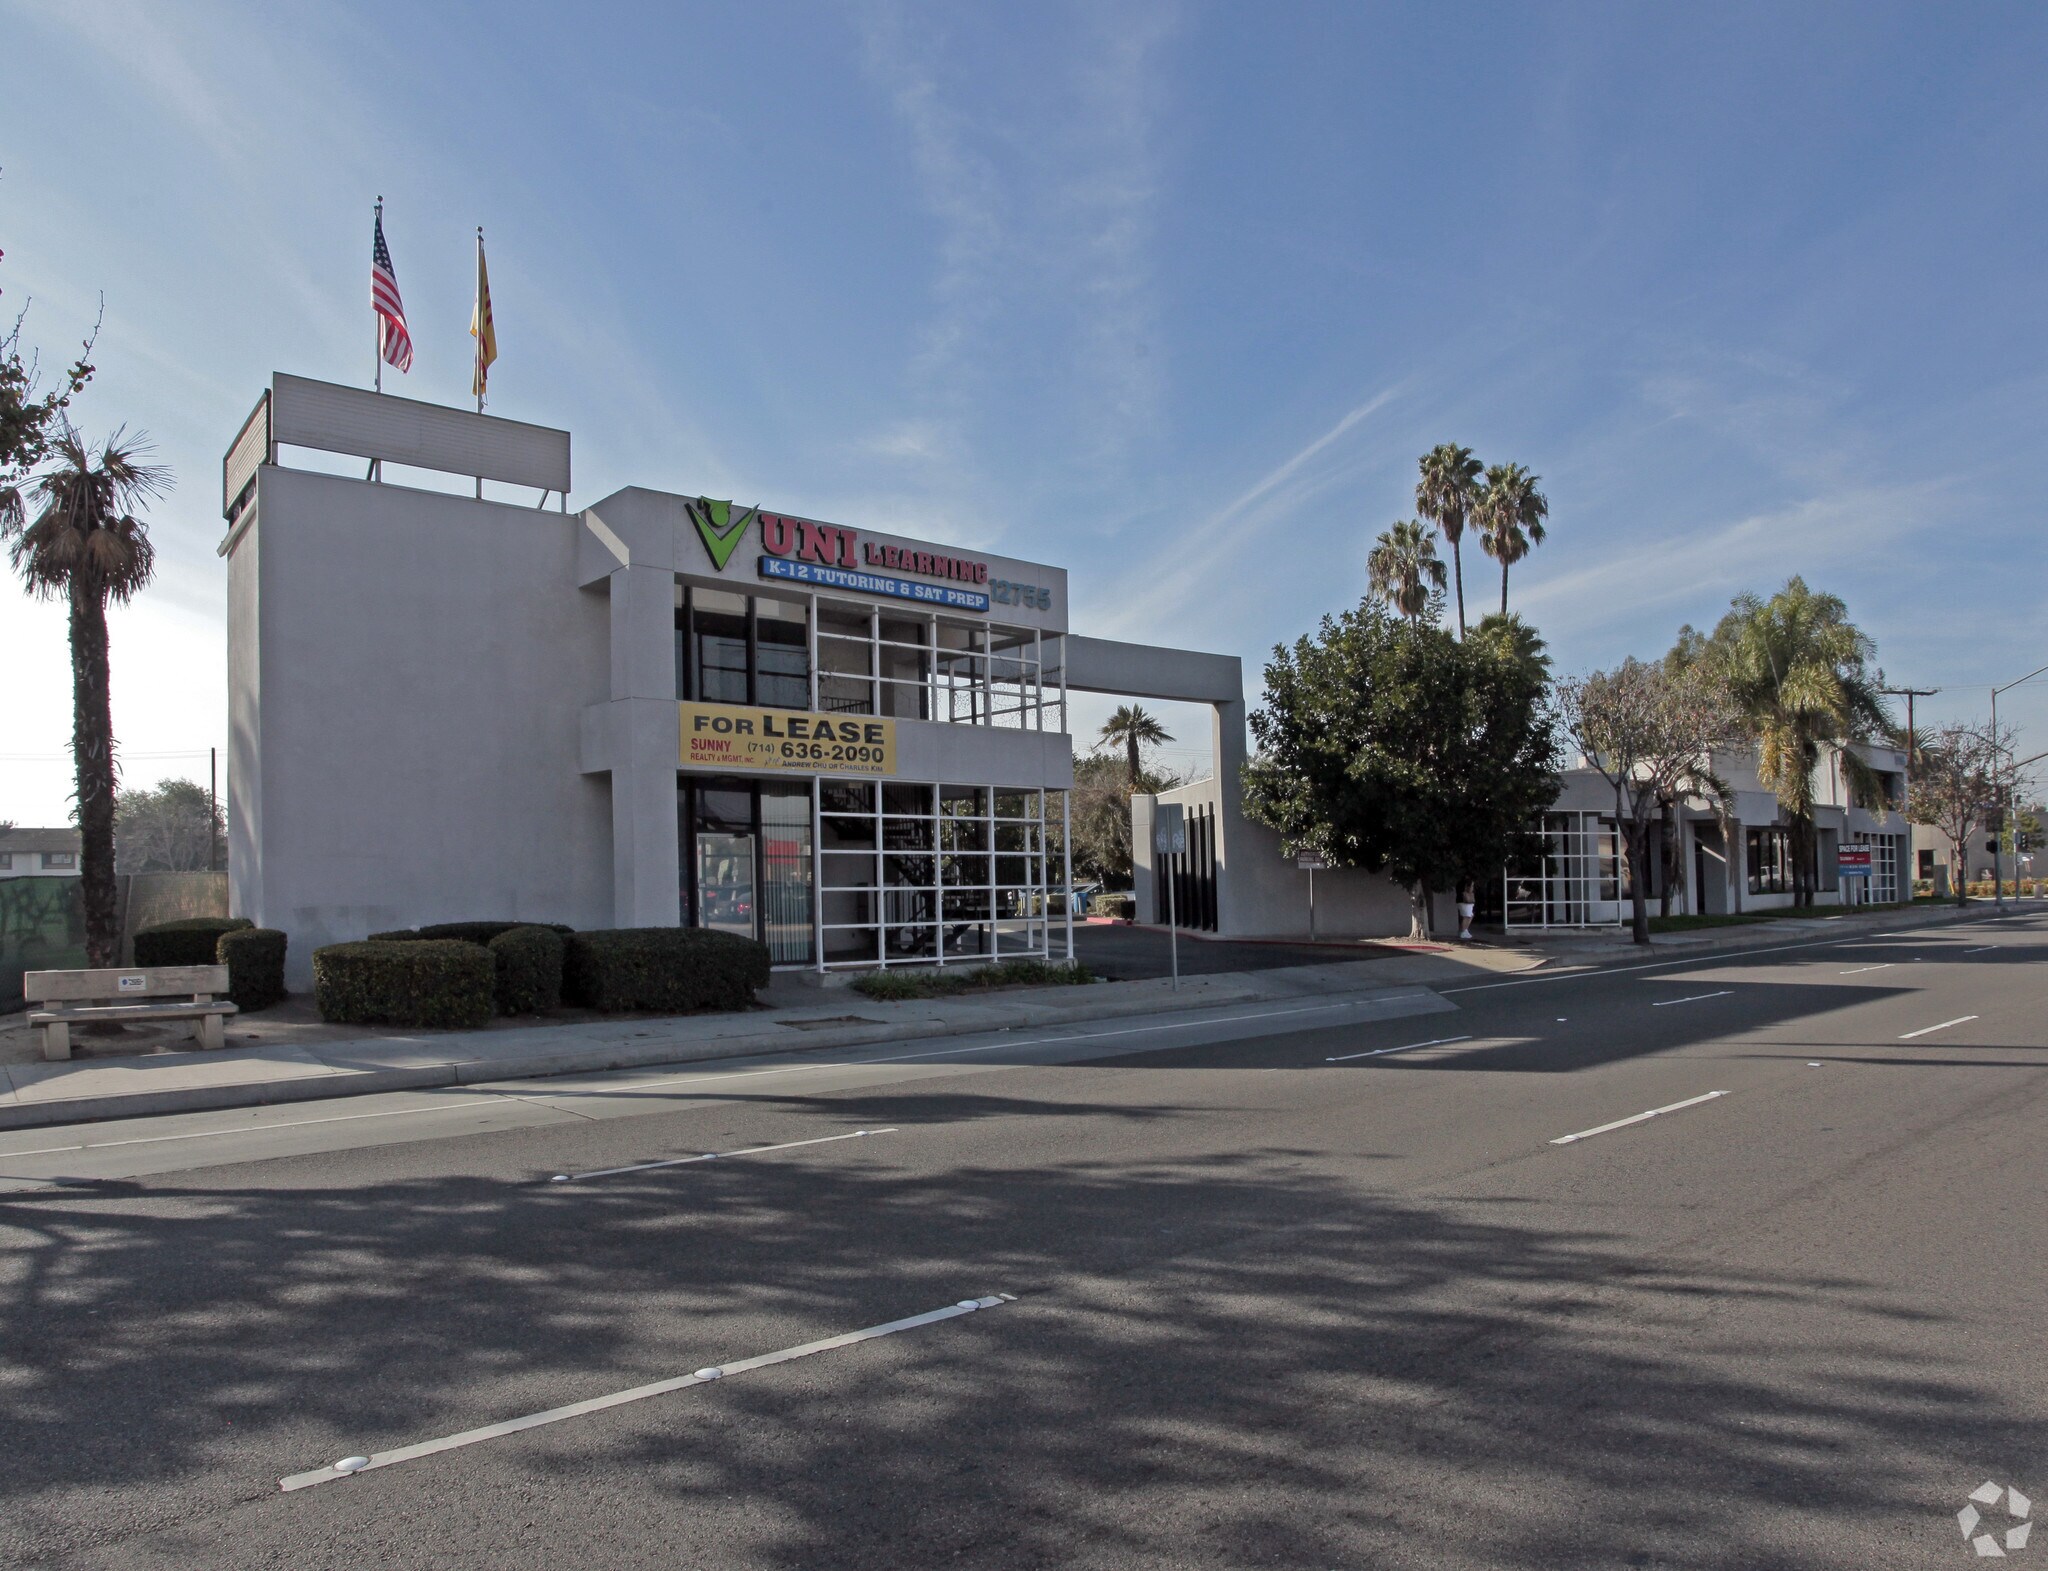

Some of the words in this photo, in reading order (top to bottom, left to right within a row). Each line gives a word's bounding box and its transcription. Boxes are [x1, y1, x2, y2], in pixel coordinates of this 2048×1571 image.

[759, 513, 858, 568] UNI
[865, 542, 988, 584] LEARNING
[769, 560, 808, 579] K-12
[813, 567, 895, 593] TUTORING
[900, 583, 910, 595] &
[914, 585, 942, 601] SAT
[947, 590, 984, 607] PREP
[988, 578, 1051, 610] 12755
[691, 738, 731, 752] SUNNY
[694, 715, 754, 735] FOR
[763, 715, 884, 745] LEASE
[690, 752, 716, 762] REALTY
[747, 742, 775, 754] (714)
[780, 741, 884, 763] 636-2090
